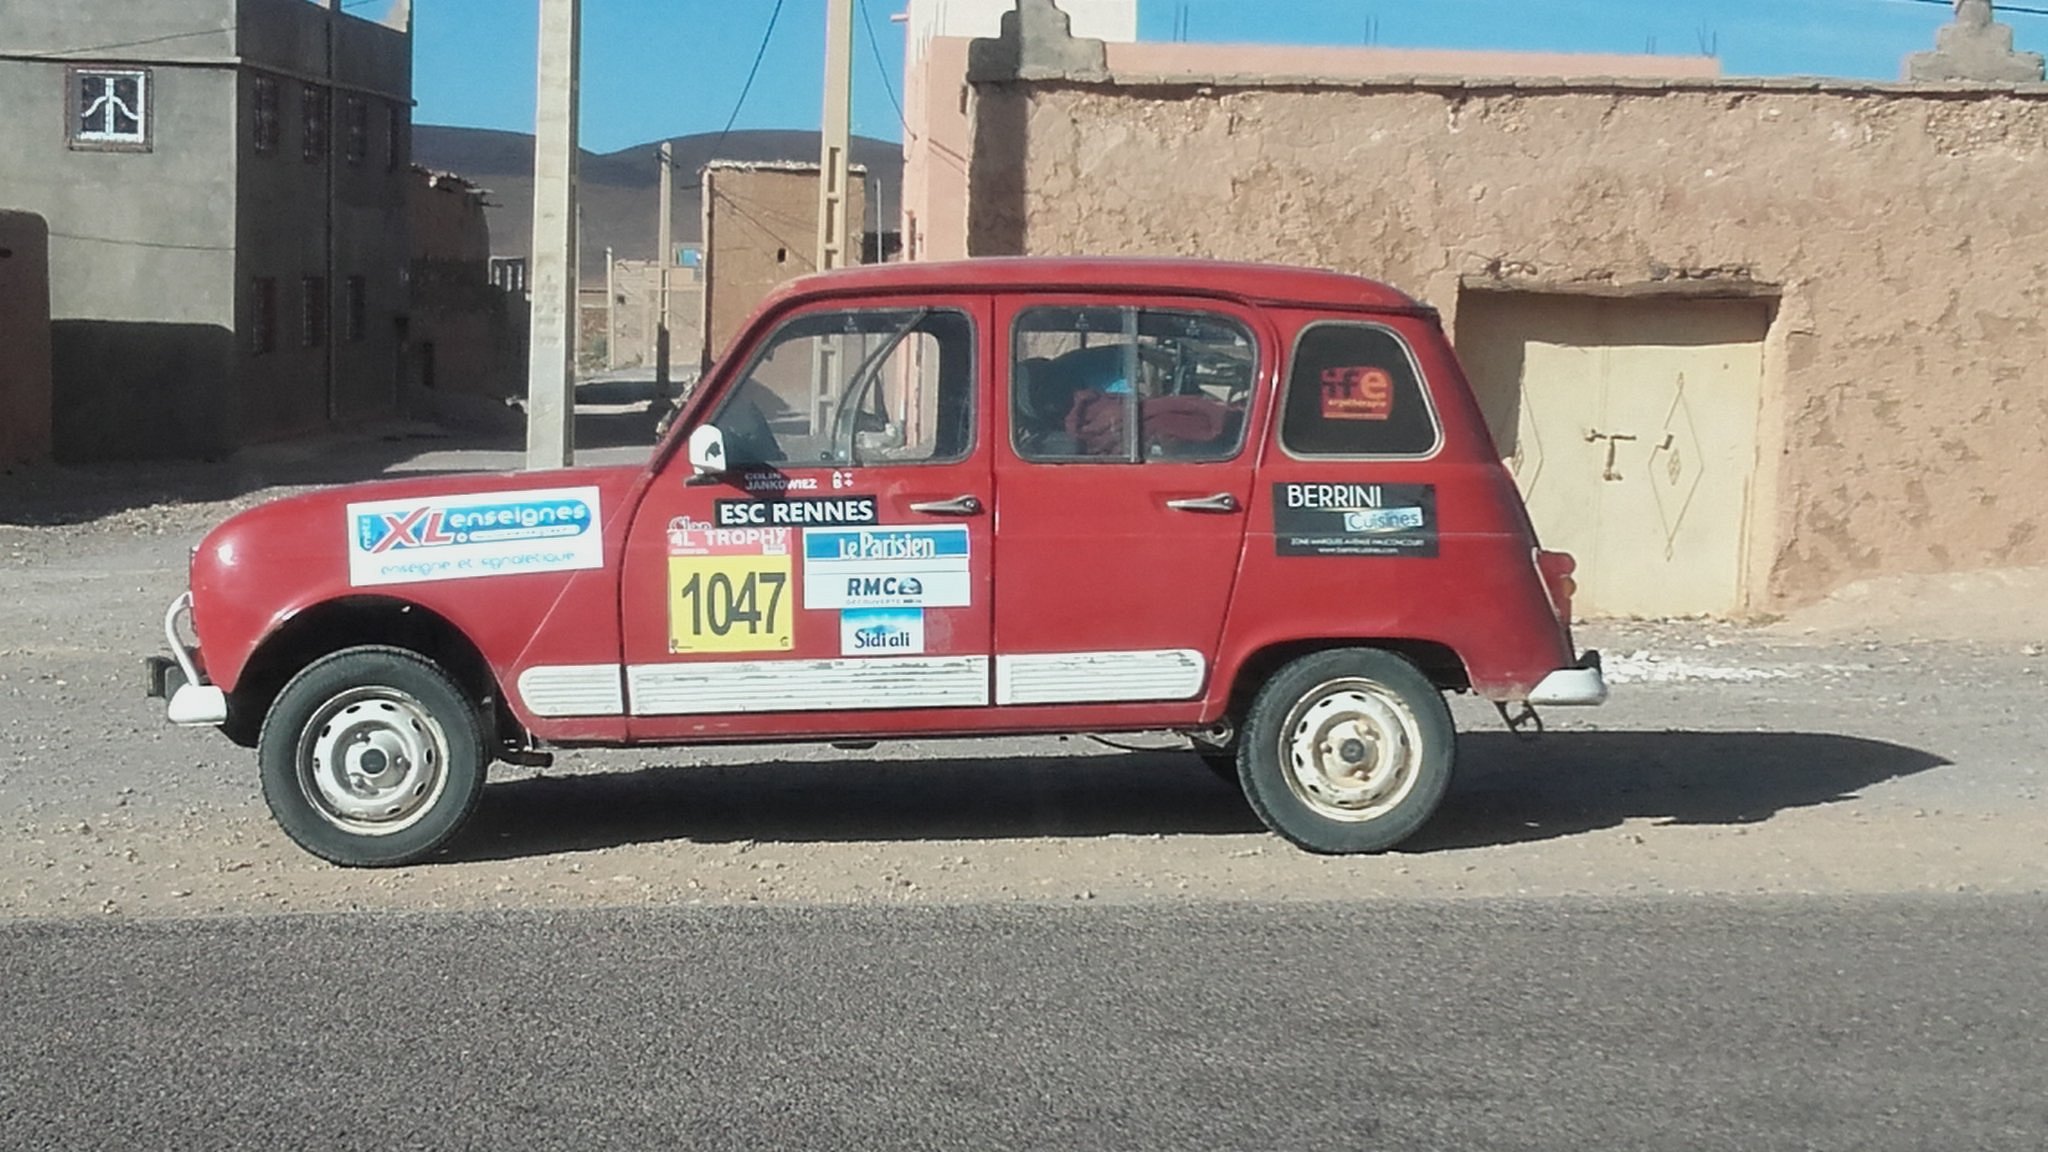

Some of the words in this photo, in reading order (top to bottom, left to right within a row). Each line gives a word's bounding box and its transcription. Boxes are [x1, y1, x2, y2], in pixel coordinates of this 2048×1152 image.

[1287, 485, 1382, 507] BERRINI
[449, 503, 587, 530] enseignes
[720, 503, 766, 525] ESC
[772, 500, 874, 523] RENNES
[1348, 511, 1419, 530] Cuisines
[704, 528, 787, 546] TROPHY
[840, 538, 858, 560] Le
[859, 531, 937, 559] Parisien
[380, 561, 451, 576] enseigne
[457, 557, 474, 569] et
[848, 577, 897, 596] RMC
[682, 571, 786, 635] 1047
[854, 628, 887, 649] Sidi
[889, 631, 910, 647] ali
